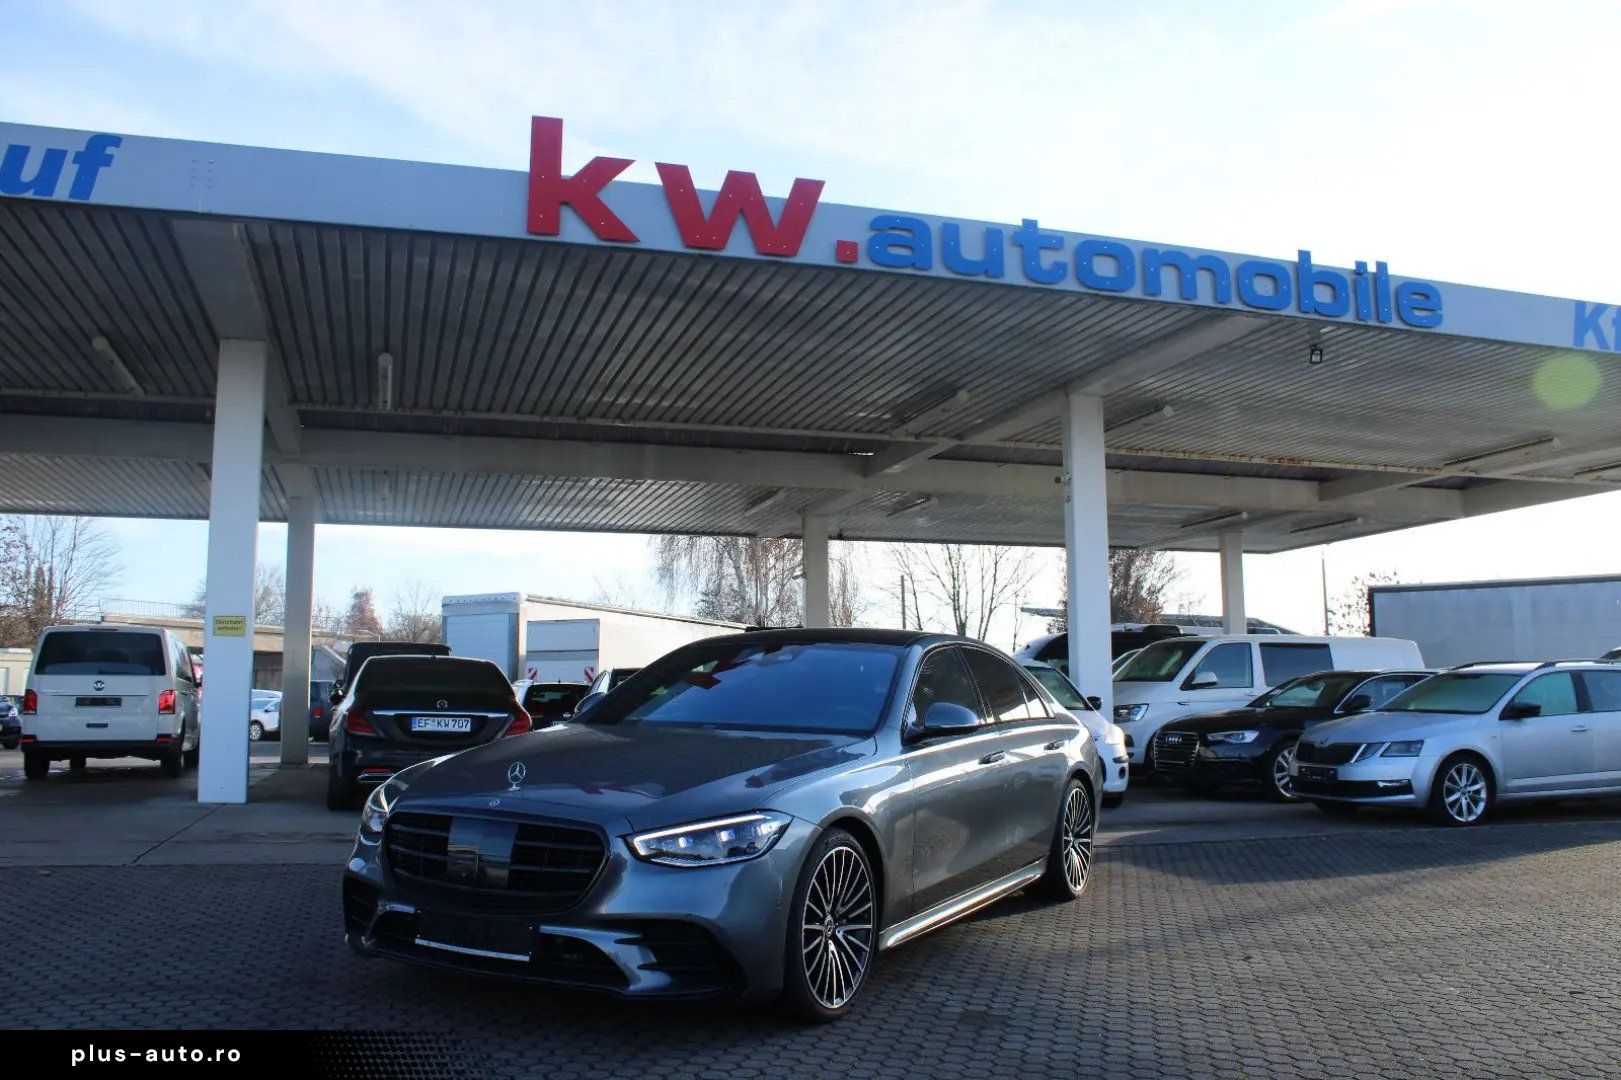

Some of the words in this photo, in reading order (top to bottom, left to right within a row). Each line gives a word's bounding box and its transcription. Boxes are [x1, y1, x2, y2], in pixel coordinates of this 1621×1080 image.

[0, 133, 123, 201] uf
[418, 718, 432, 728] EF
[452, 719, 470, 729] 707
